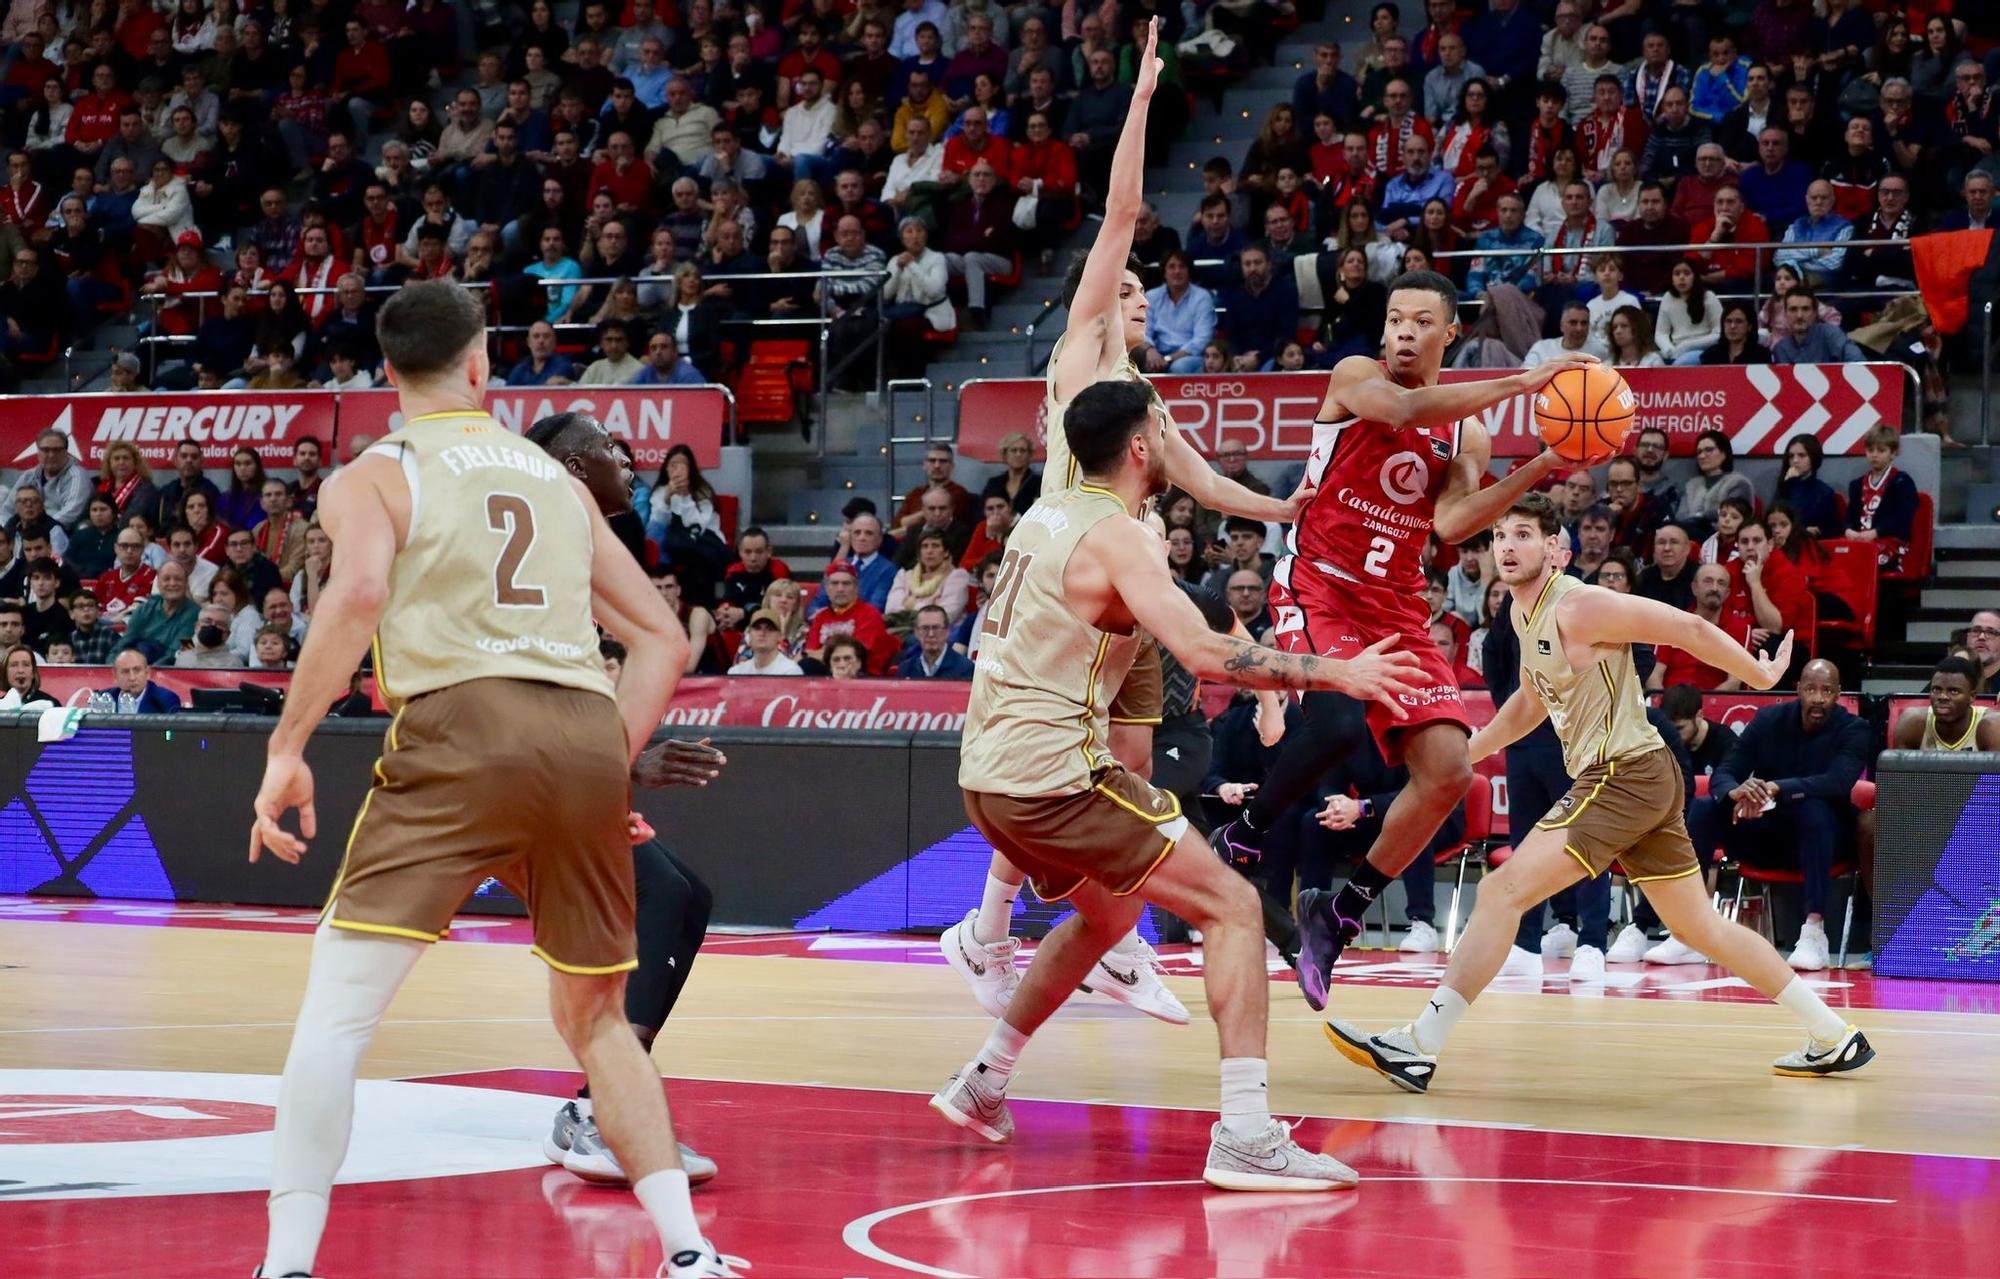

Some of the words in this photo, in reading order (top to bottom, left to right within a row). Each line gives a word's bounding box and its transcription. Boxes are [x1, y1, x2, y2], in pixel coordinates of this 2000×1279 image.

[1180, 381, 1245, 398] GRUPO
[1632, 391, 1726, 408] SUMAMOS
[92, 404, 304, 442] MERCURY
[1164, 396, 1319, 452] RBE
[1632, 411, 1725, 433] ENERGÍAS
[440, 445, 558, 482] FJELLERUP
[1362, 517, 1410, 540] ZARAGOZA
[484, 491, 548, 609] 2
[1363, 535, 1395, 578] 2
[981, 548, 1034, 641] 21
[761, 695, 968, 730] Casademo
